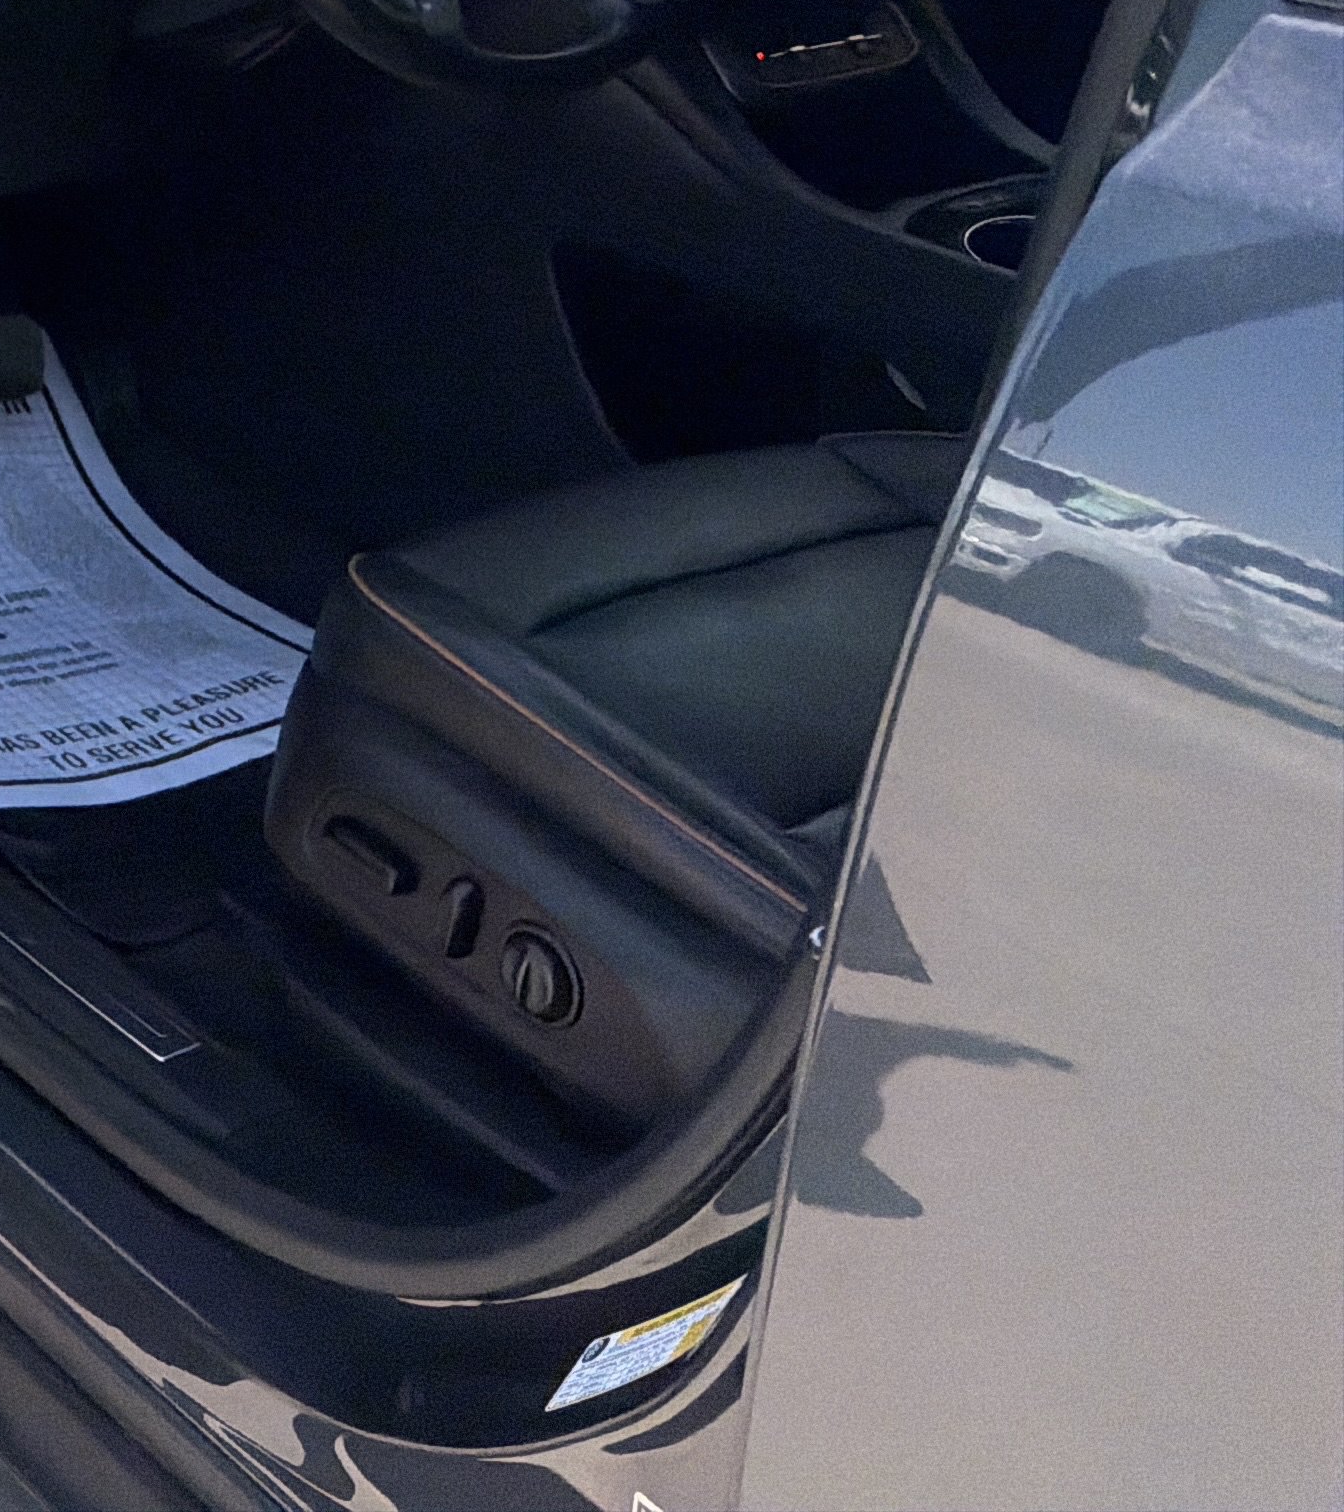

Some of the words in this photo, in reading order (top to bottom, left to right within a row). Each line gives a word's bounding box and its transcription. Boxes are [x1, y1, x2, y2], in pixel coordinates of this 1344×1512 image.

[39, 718, 118, 747] BEEN
[119, 714, 144, 732] A
[140, 669, 286, 724] PLEASURE
[44, 751, 88, 772] TO
[86, 728, 183, 764] SERVE
[178, 705, 245, 736] YOU
